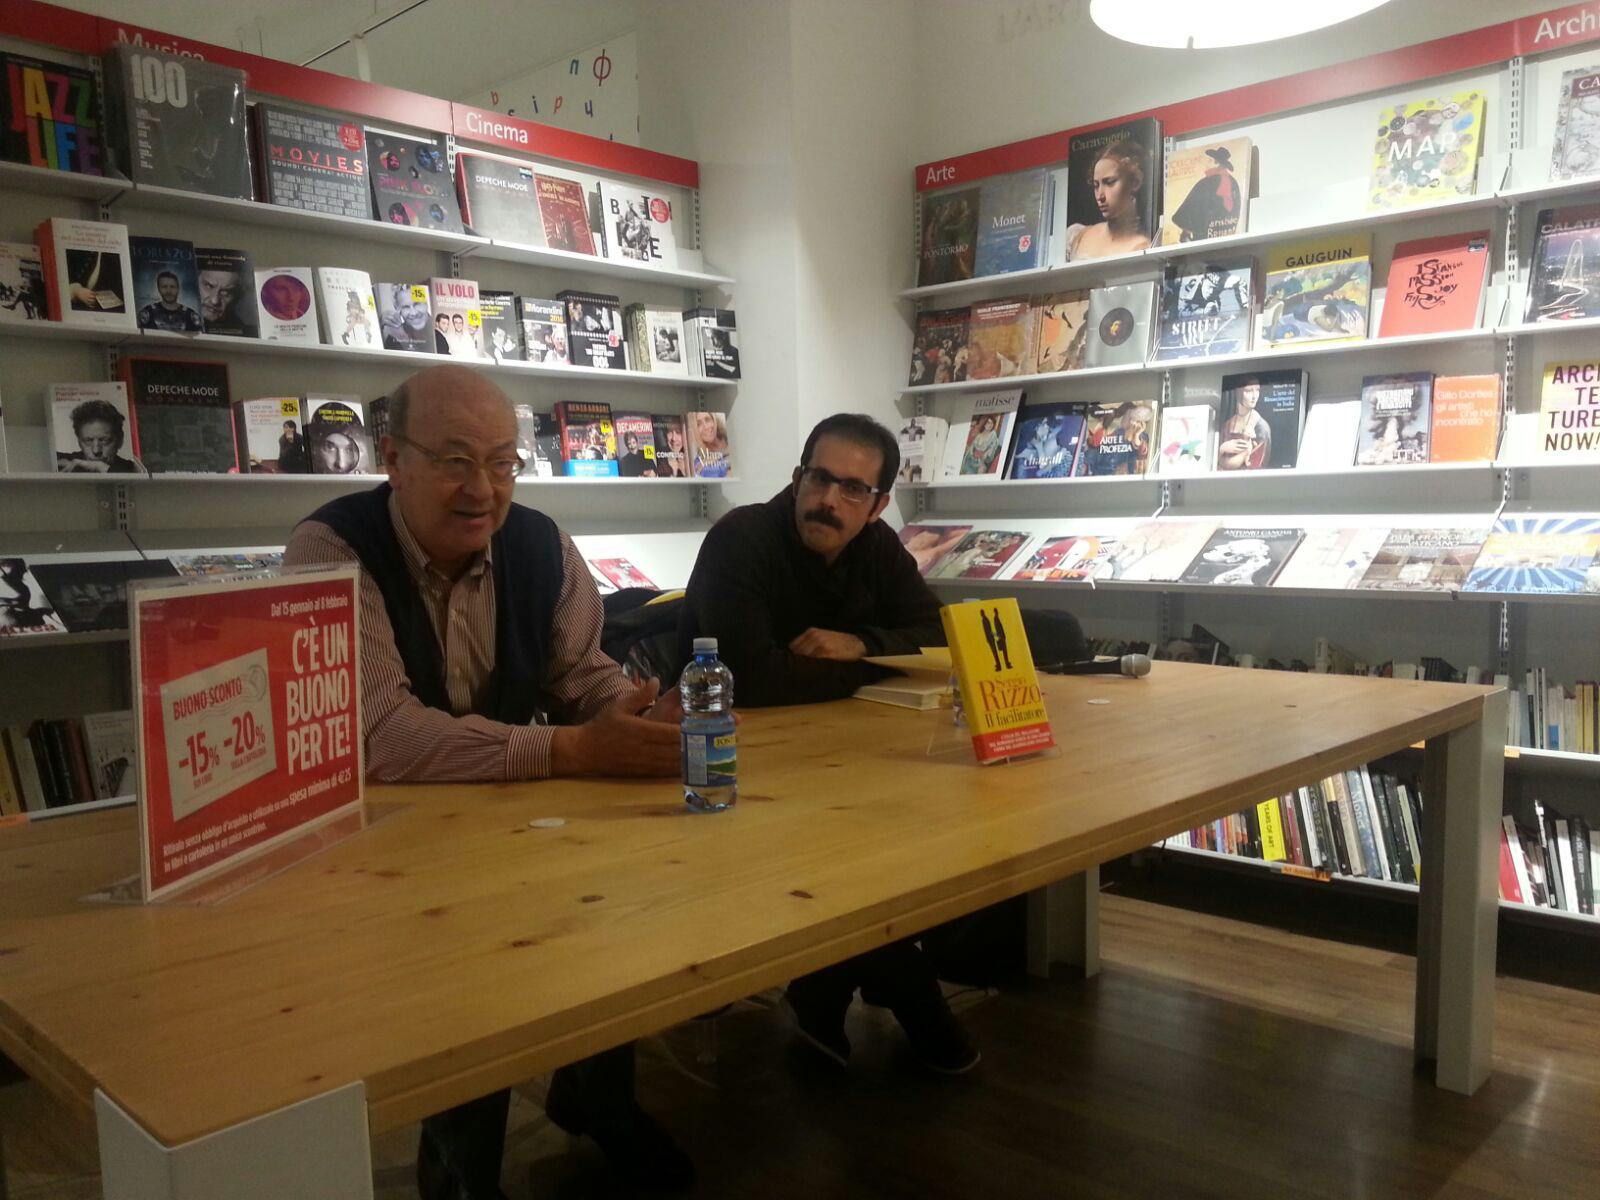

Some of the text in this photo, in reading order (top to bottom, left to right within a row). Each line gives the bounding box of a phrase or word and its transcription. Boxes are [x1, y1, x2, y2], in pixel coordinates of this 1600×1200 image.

[131, 53, 188, 108] 100
[7, 62, 98, 133] JAZZ
[466, 111, 529, 143] Cinema
[27, 117, 104, 177] LIFE
[1387, 132, 1457, 163] MAP
[270, 144, 363, 173] MOVIES
[475, 174, 528, 192] DEPECHE MODE
[926, 167, 956, 184] Arte
[992, 213, 1026, 229] Monet
[923, 243, 969, 259] PONTORMO
[1286, 247, 1353, 268] GAUGUIN
[435, 283, 474, 298] IL VOLO
[147, 384, 220, 396] DEPECHE MODE
[974, 395, 1015, 408] matisse
[1099, 443, 1133, 454] PROFEZIA
[1101, 435, 1123, 445] ARTE E
[1024, 452, 1062, 466] chagall
[323, 621, 348, 668] UN
[173, 676, 242, 721] BUONO SCONTO
[286, 667, 349, 726] BUONO
[985, 712, 994, 728] Il
[179, 711, 266, 777] -15% -20%
[287, 713, 351, 776] PER TE!
[289, 788, 307, 807] spesa
